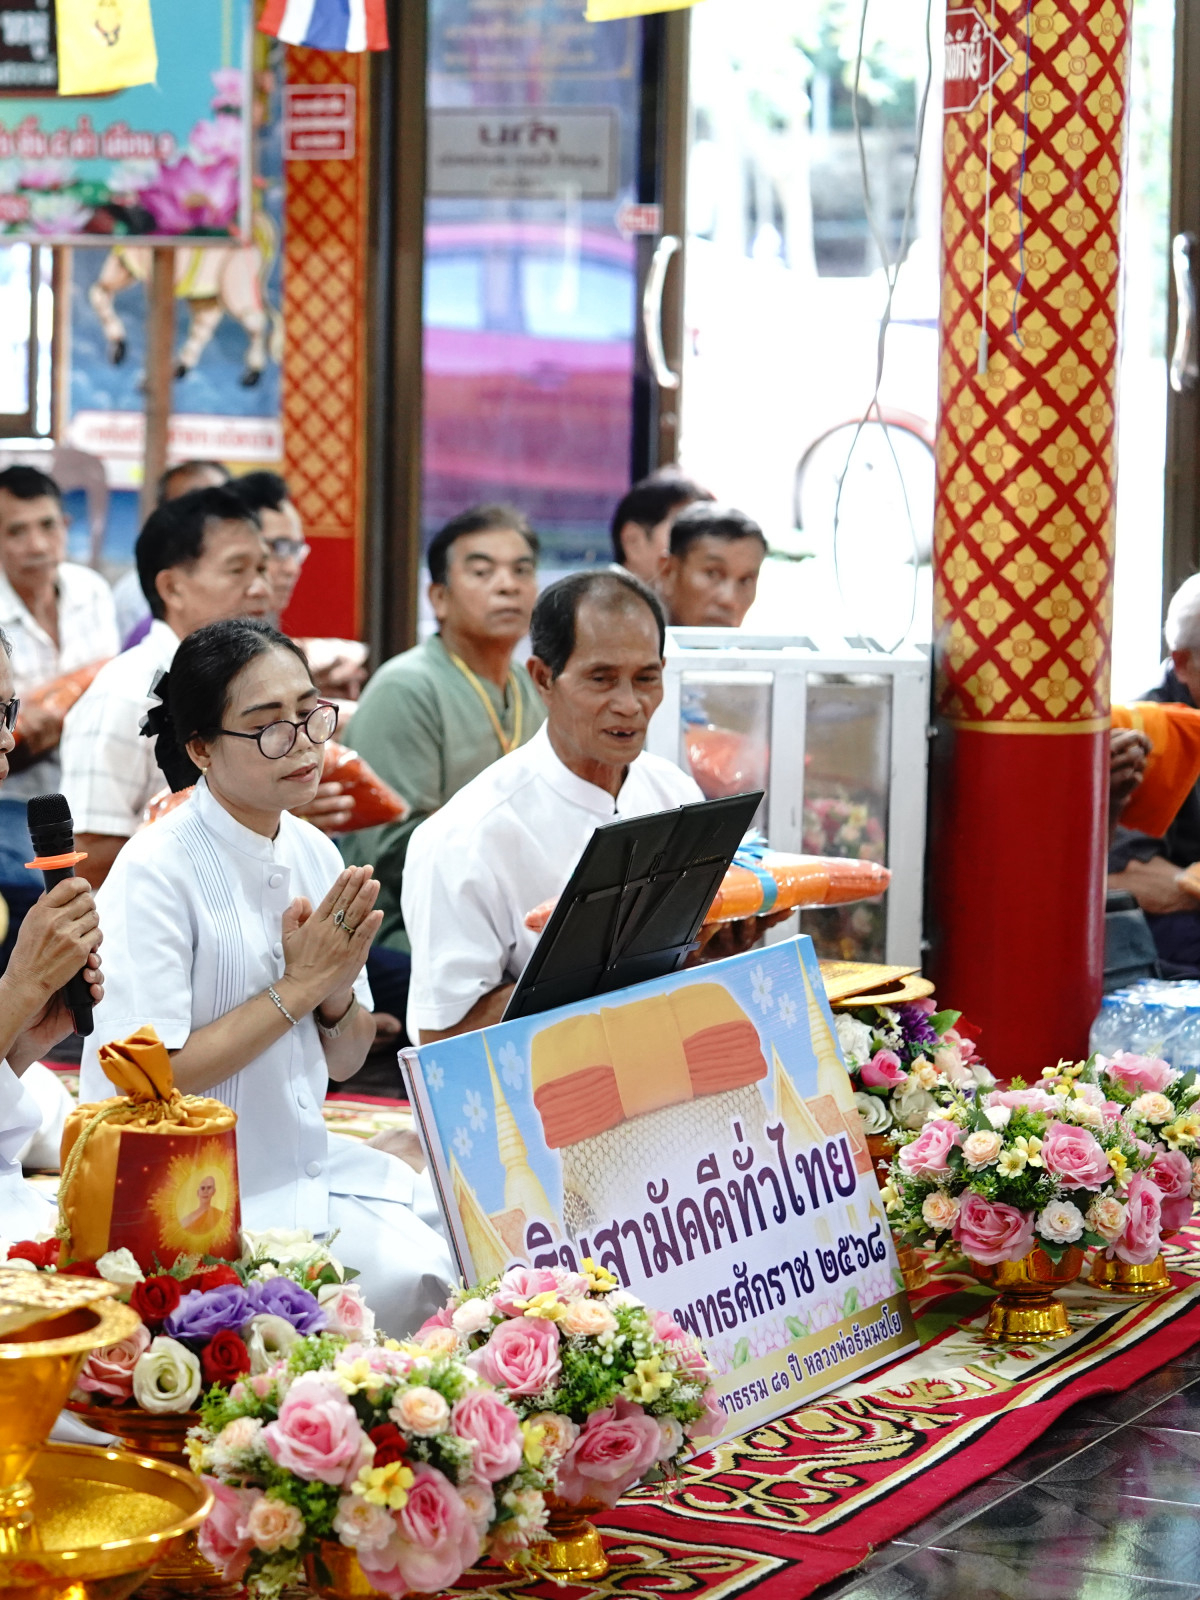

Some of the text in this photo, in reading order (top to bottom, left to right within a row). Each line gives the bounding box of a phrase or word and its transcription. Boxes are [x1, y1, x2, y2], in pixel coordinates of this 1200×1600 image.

[506, 1121, 857, 1289] ินสามัคคีทั่วไทย
[673, 1222, 887, 1342] พทธศักราช ๒๕๖๘
[770, 1371, 791, 1394] ๘๑
[787, 1352, 803, 1382] ปี
[803, 1303, 902, 1377] หลวงพ่อธัมมชโย
